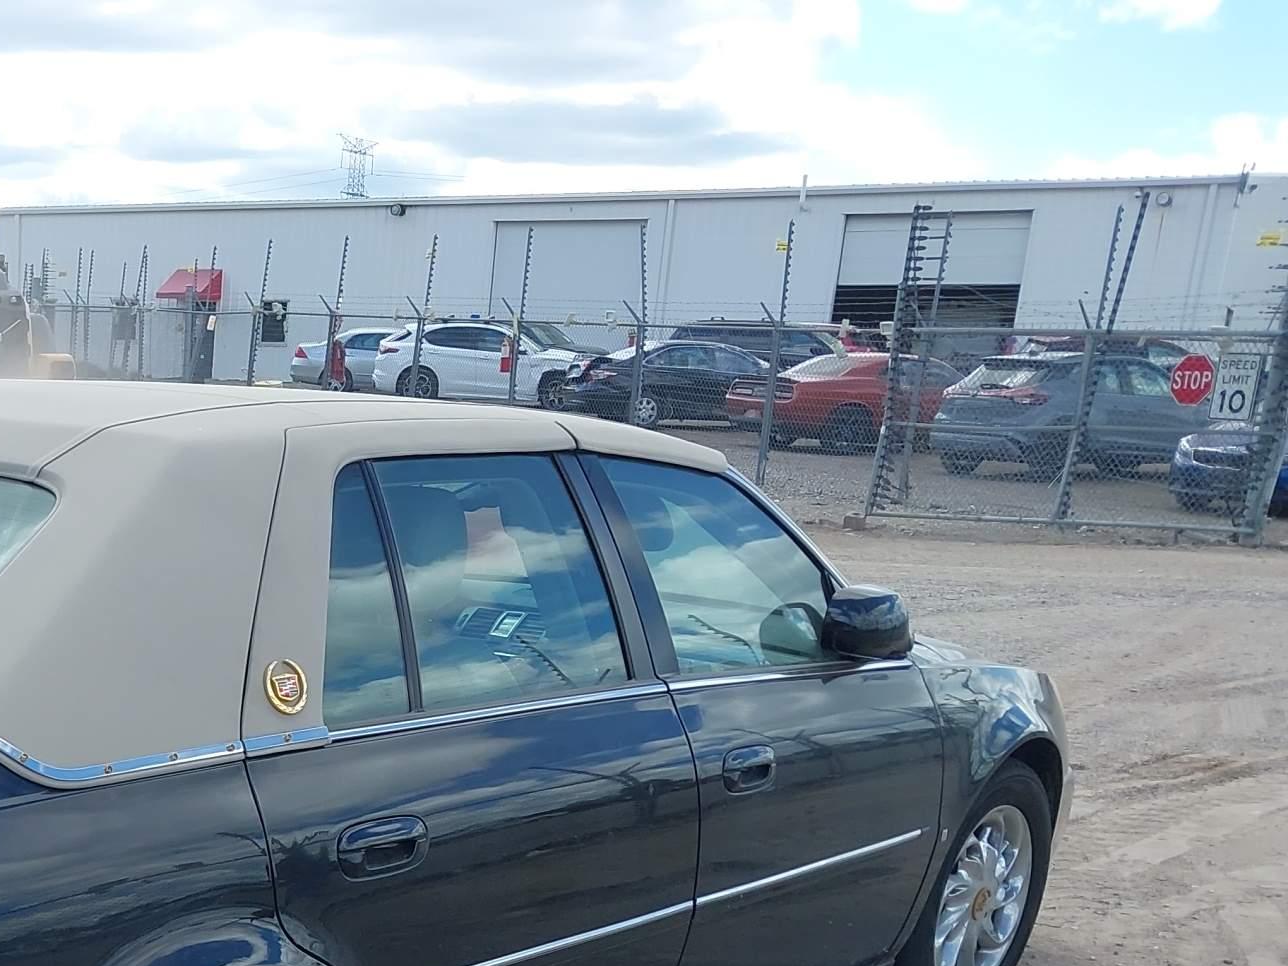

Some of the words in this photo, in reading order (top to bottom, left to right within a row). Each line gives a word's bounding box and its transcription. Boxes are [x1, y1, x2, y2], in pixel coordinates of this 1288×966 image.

[1221, 360, 1257, 370] SPEED
[1173, 371, 1211, 389] STOP
[1222, 375, 1251, 384] LIMIT
[1219, 390, 1246, 413] 10
